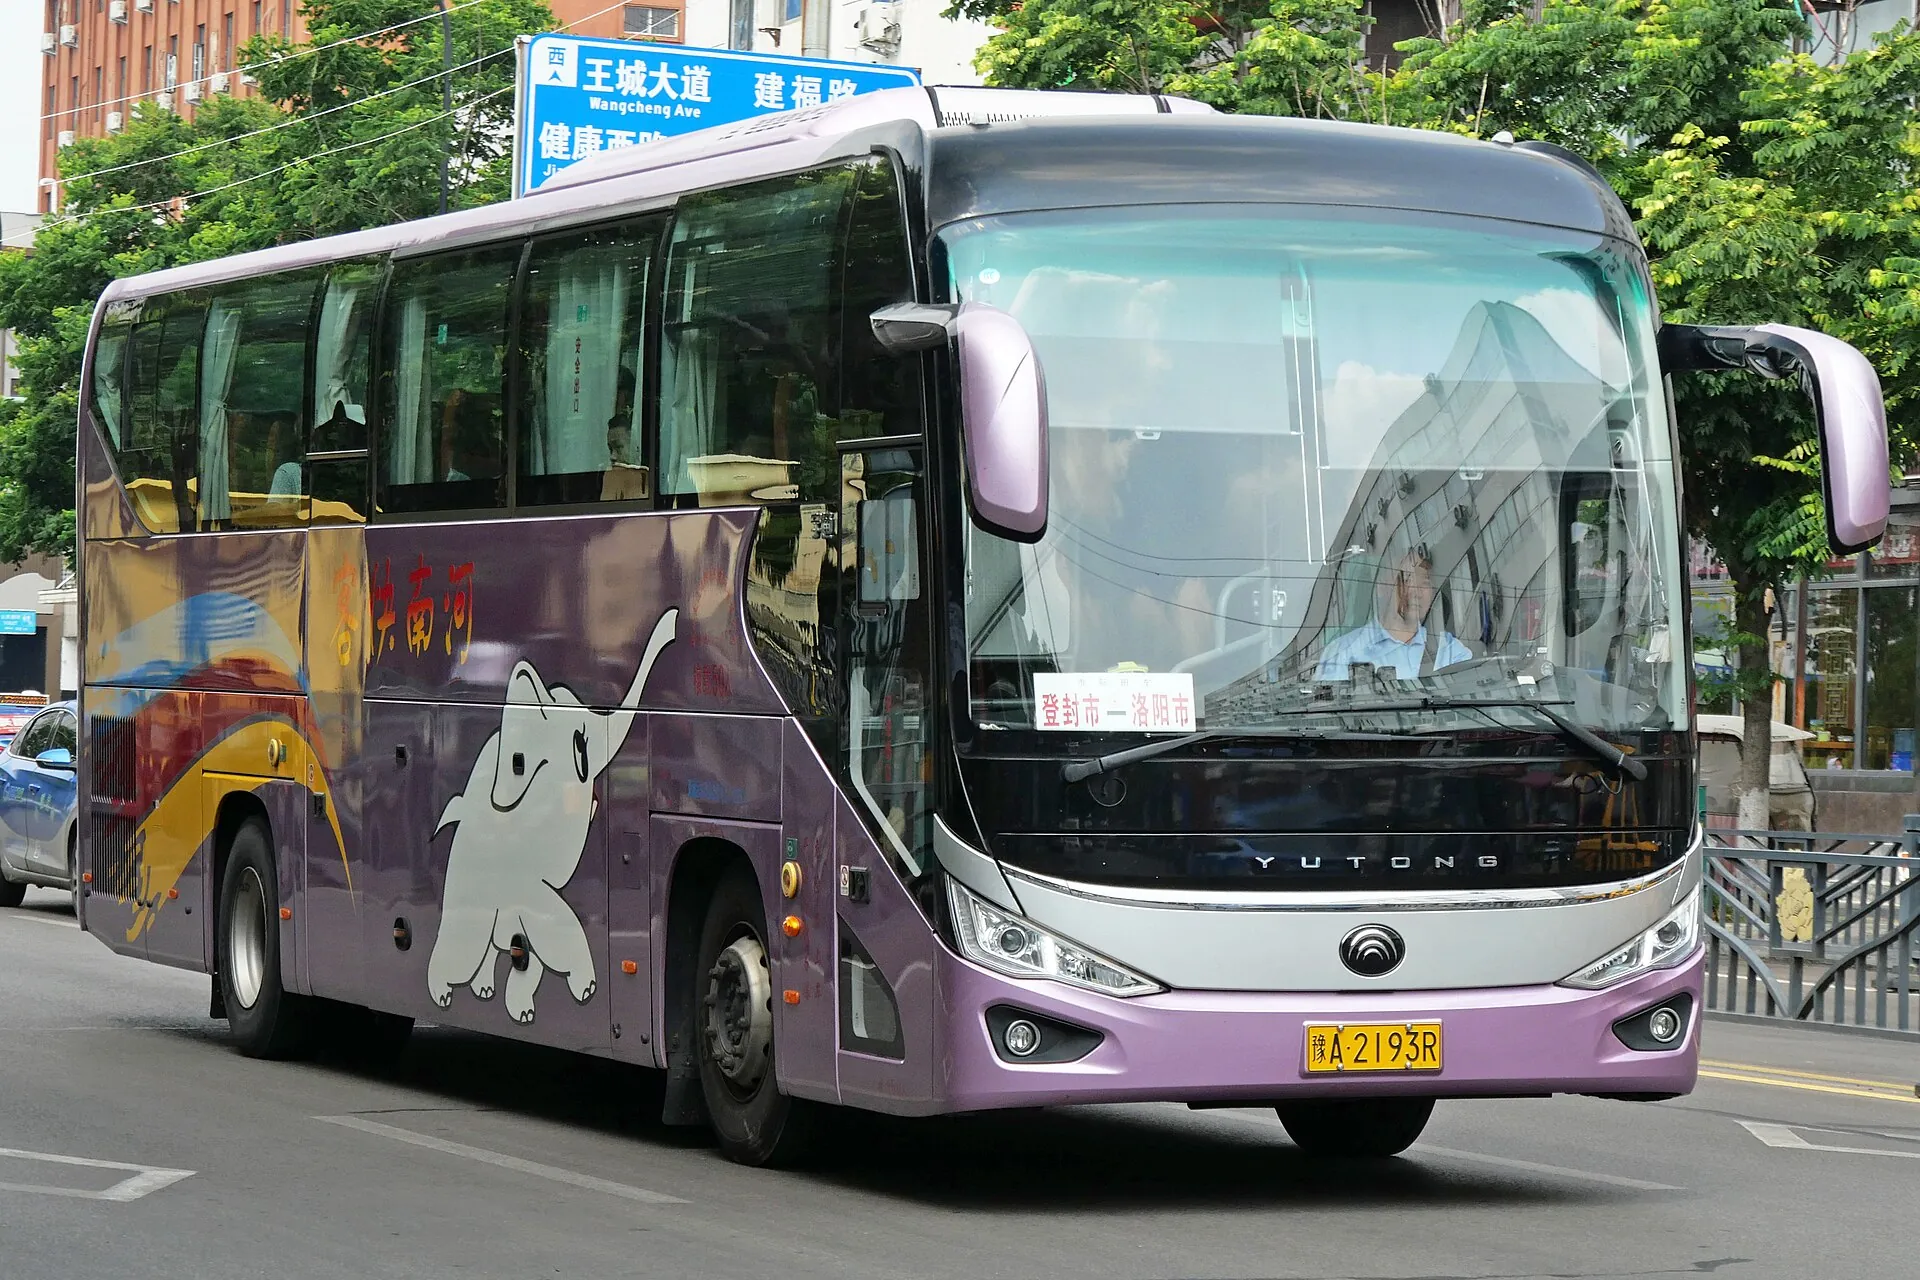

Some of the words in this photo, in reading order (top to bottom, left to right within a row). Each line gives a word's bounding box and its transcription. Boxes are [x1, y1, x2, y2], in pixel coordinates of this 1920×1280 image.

[547, 46, 566, 66] 西
[582, 57, 712, 103] 王城大道
[589, 96, 671, 119] Wangcheng
[673, 103, 701, 119] Ave
[1255, 856, 1498, 869] YUTONG
